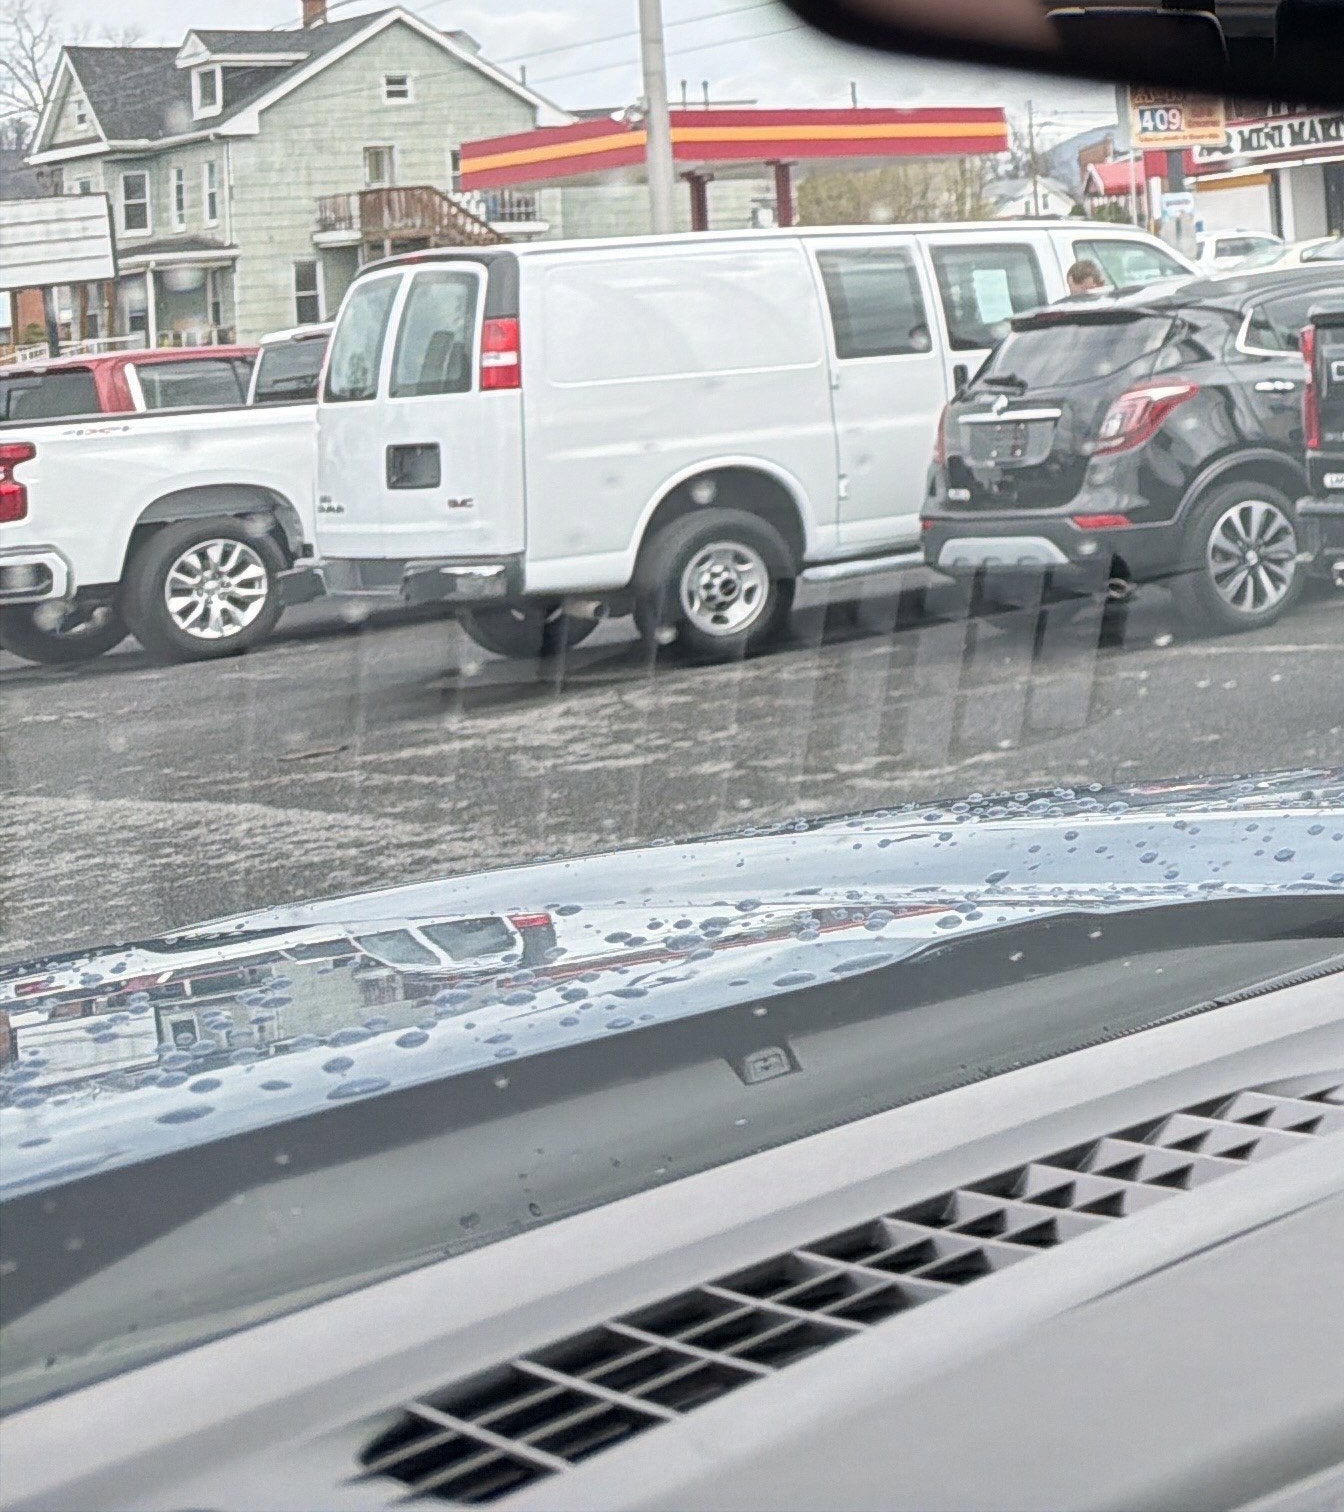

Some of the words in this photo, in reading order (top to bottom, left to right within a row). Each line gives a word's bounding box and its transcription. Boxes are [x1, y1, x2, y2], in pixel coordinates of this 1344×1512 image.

[1142, 108, 1181, 131] 409
[1237, 123, 1285, 152] MINI
[1287, 114, 1344, 146] MART
